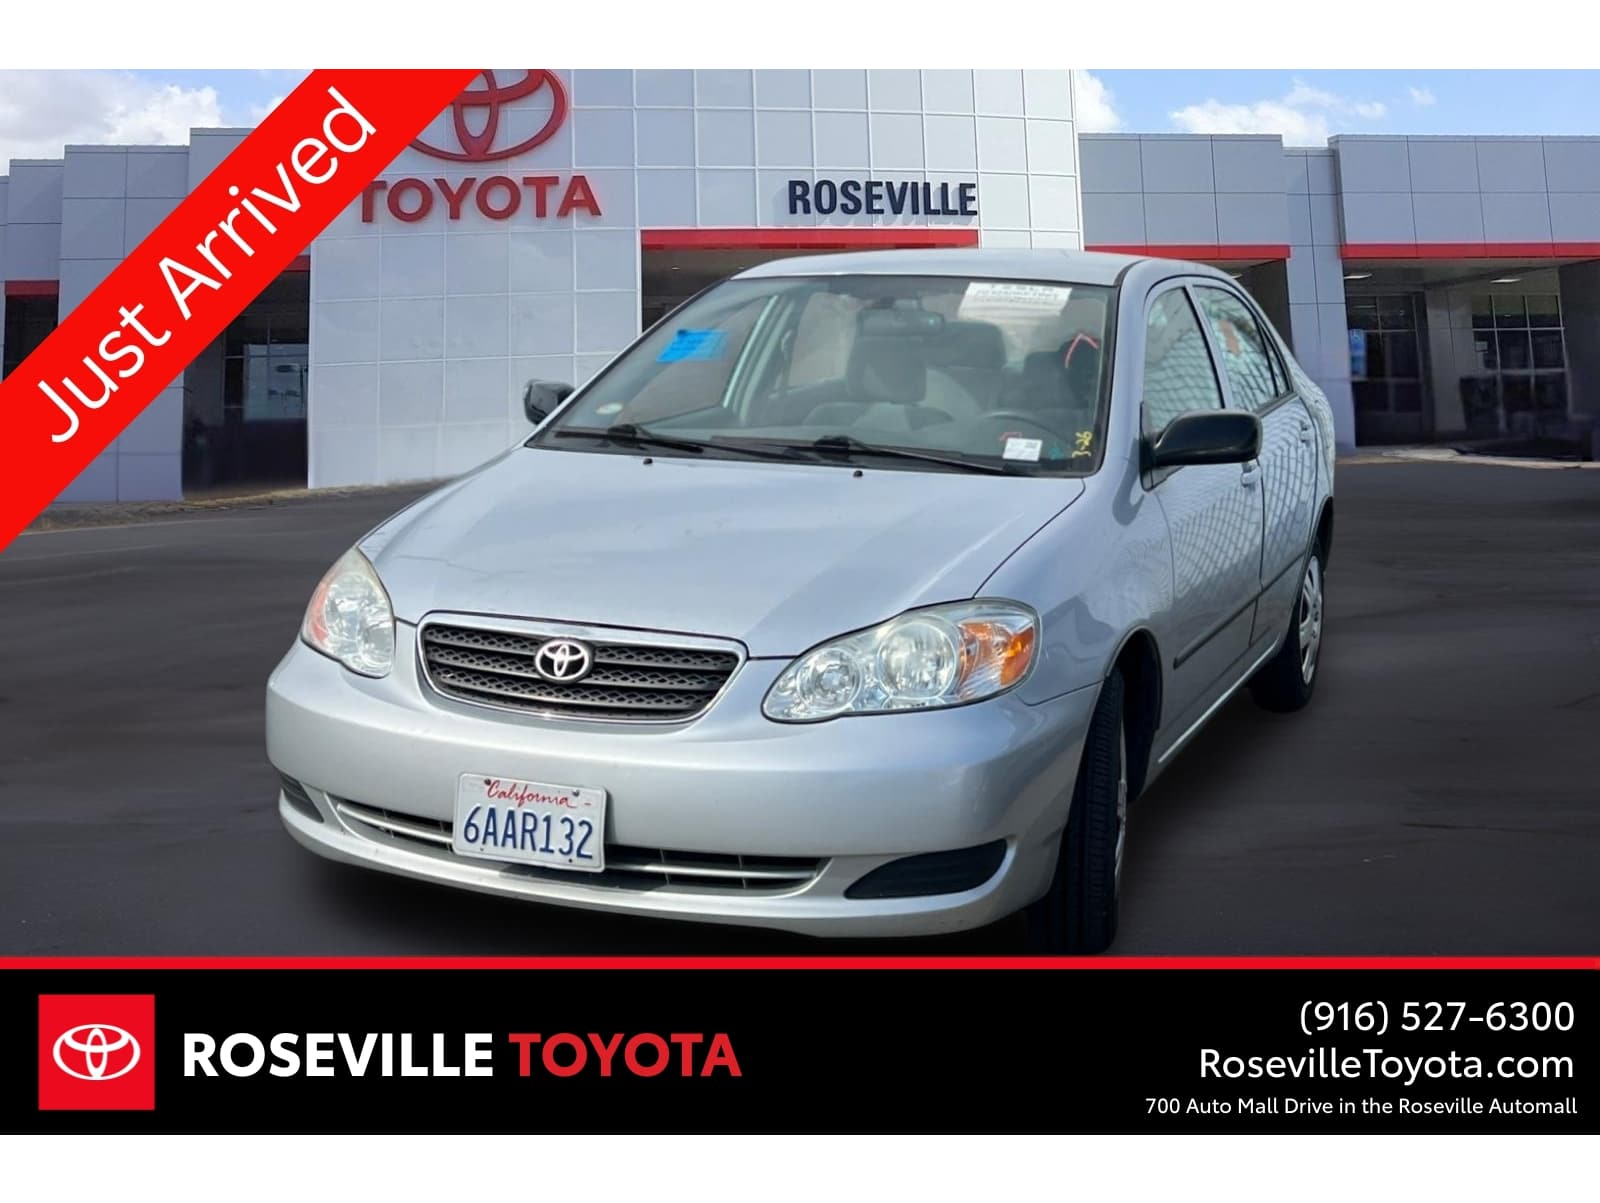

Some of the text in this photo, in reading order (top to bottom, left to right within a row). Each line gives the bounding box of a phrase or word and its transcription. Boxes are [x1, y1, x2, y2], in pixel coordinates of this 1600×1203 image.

[361, 175, 602, 223] TOYOTA
[788, 179, 979, 217] ROSEVILLE
[486, 779, 577, 809] California
[463, 804, 594, 860] 6AAR132
